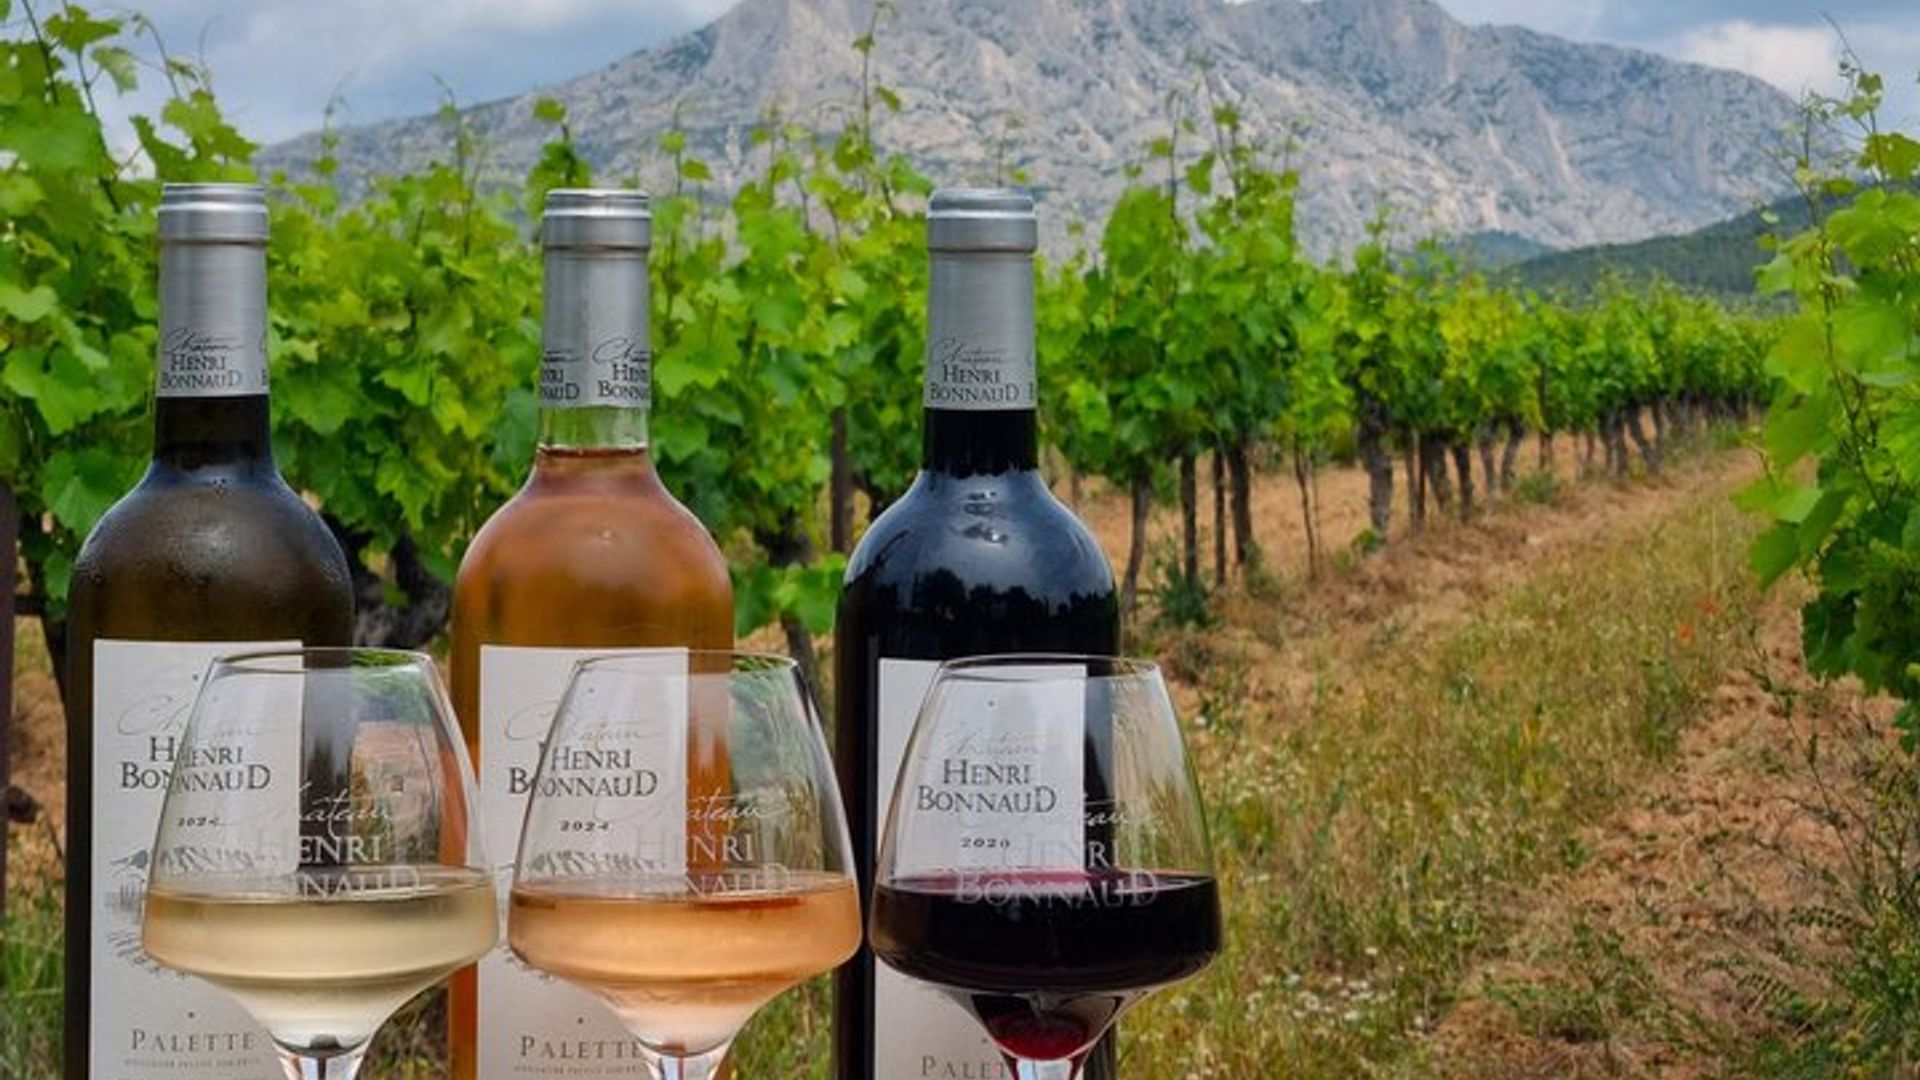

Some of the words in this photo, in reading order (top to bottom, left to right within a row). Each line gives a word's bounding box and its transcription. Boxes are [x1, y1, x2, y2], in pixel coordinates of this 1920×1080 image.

[171, 354, 226, 370] HENRI
[943, 365, 999, 384] HENRI
[930, 384, 1020, 402] BONNAUD
[150, 736, 243, 768] HENRI
[539, 741, 632, 771] HENRI
[121, 761, 271, 794] BONNAUD
[509, 767, 658, 797] BONNAUD
[943, 759, 1031, 785] HENRI
[917, 785, 1057, 813] BONNAUD
[559, 820, 610, 832] 2024
[961, 838, 1011, 849] 2020
[955, 868, 1158, 909] BONNAUD
[131, 1028, 256, 1052] PALETTE
